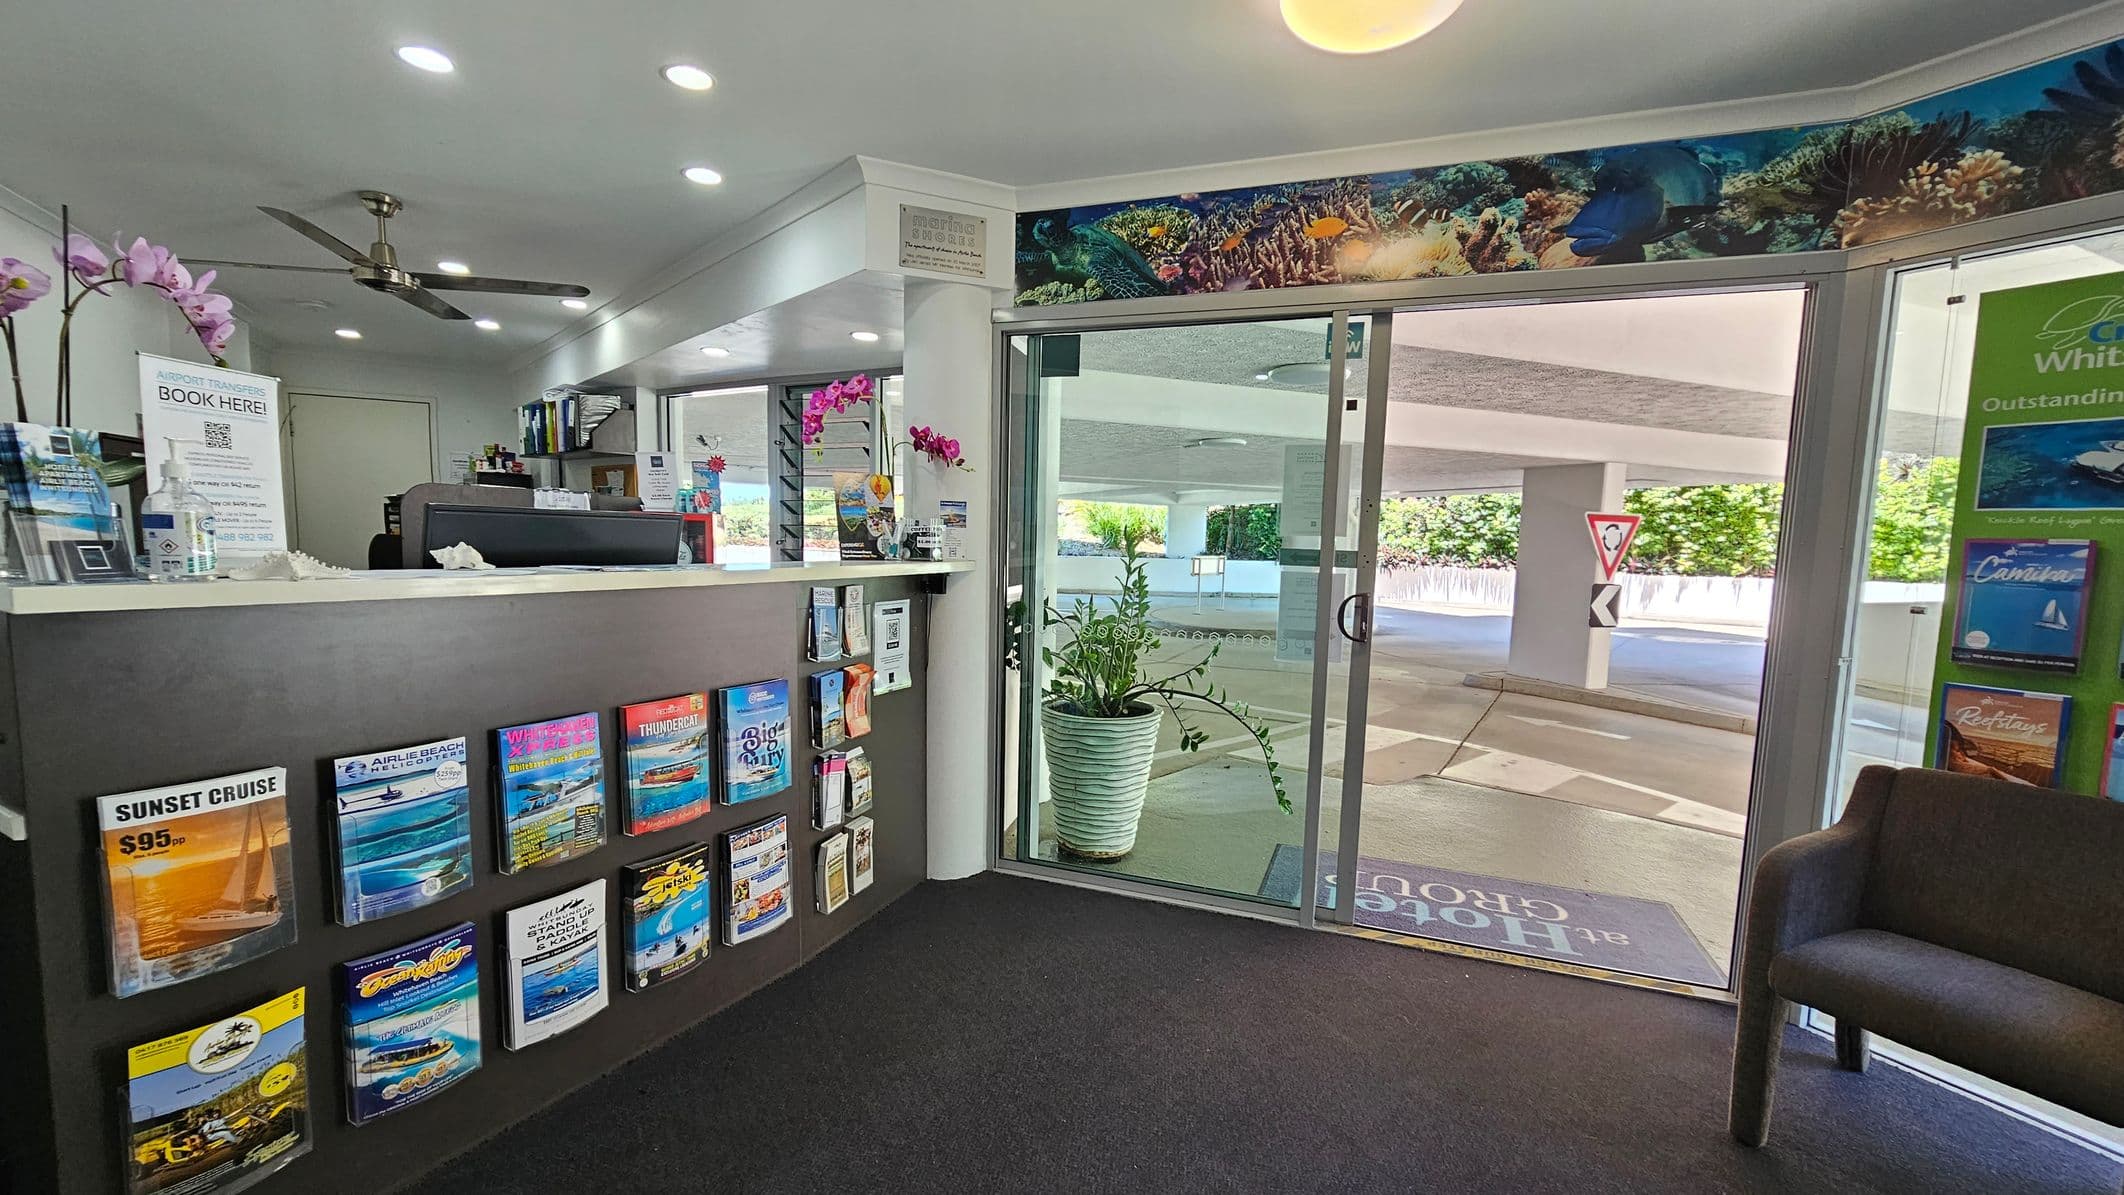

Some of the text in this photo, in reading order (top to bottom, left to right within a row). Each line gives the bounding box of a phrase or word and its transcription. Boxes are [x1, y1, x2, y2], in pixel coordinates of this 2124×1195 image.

[912, 215, 976, 235] marina
[912, 228, 975, 247] SHORES
[157, 370, 266, 397] AIRPORT TRANSFERS
[159, 385, 215, 408] BOOK
[220, 395, 267, 415] HERE!
[1982, 388, 2124, 412] Outstandin
[1974, 555, 2076, 583] Camira
[506, 716, 596, 745] WHITEHAVEN
[639, 713, 699, 737] THUNDERCAT
[1955, 706, 2049, 735] Reefstays
[506, 730, 597, 758] XPRESS
[741, 719, 778, 751] Big
[370, 749, 465, 773] HELICOPTERS
[371, 741, 464, 766] AIRLIE BEACH
[737, 746, 784, 773] Fury
[115, 776, 277, 822] SUNSET CRUISE
[662, 874, 692, 893] jetski
[527, 917, 576, 938] STAND
[579, 907, 596, 919] UP
[528, 903, 594, 930] WHITSUNDAY
[536, 918, 590, 943] PADDLE
[536, 943, 546, 952] &
[550, 926, 589, 948] KAYAK
[1576, 928, 1631, 946] at
[375, 956, 394, 966] BEACH
[377, 1000, 390, 1008] Hill
[389, 994, 405, 1004] Inlet
[405, 985, 431, 998] Lookout
[435, 974, 459, 987] Beaches
[392, 973, 448, 997] Whitehaven Beach
